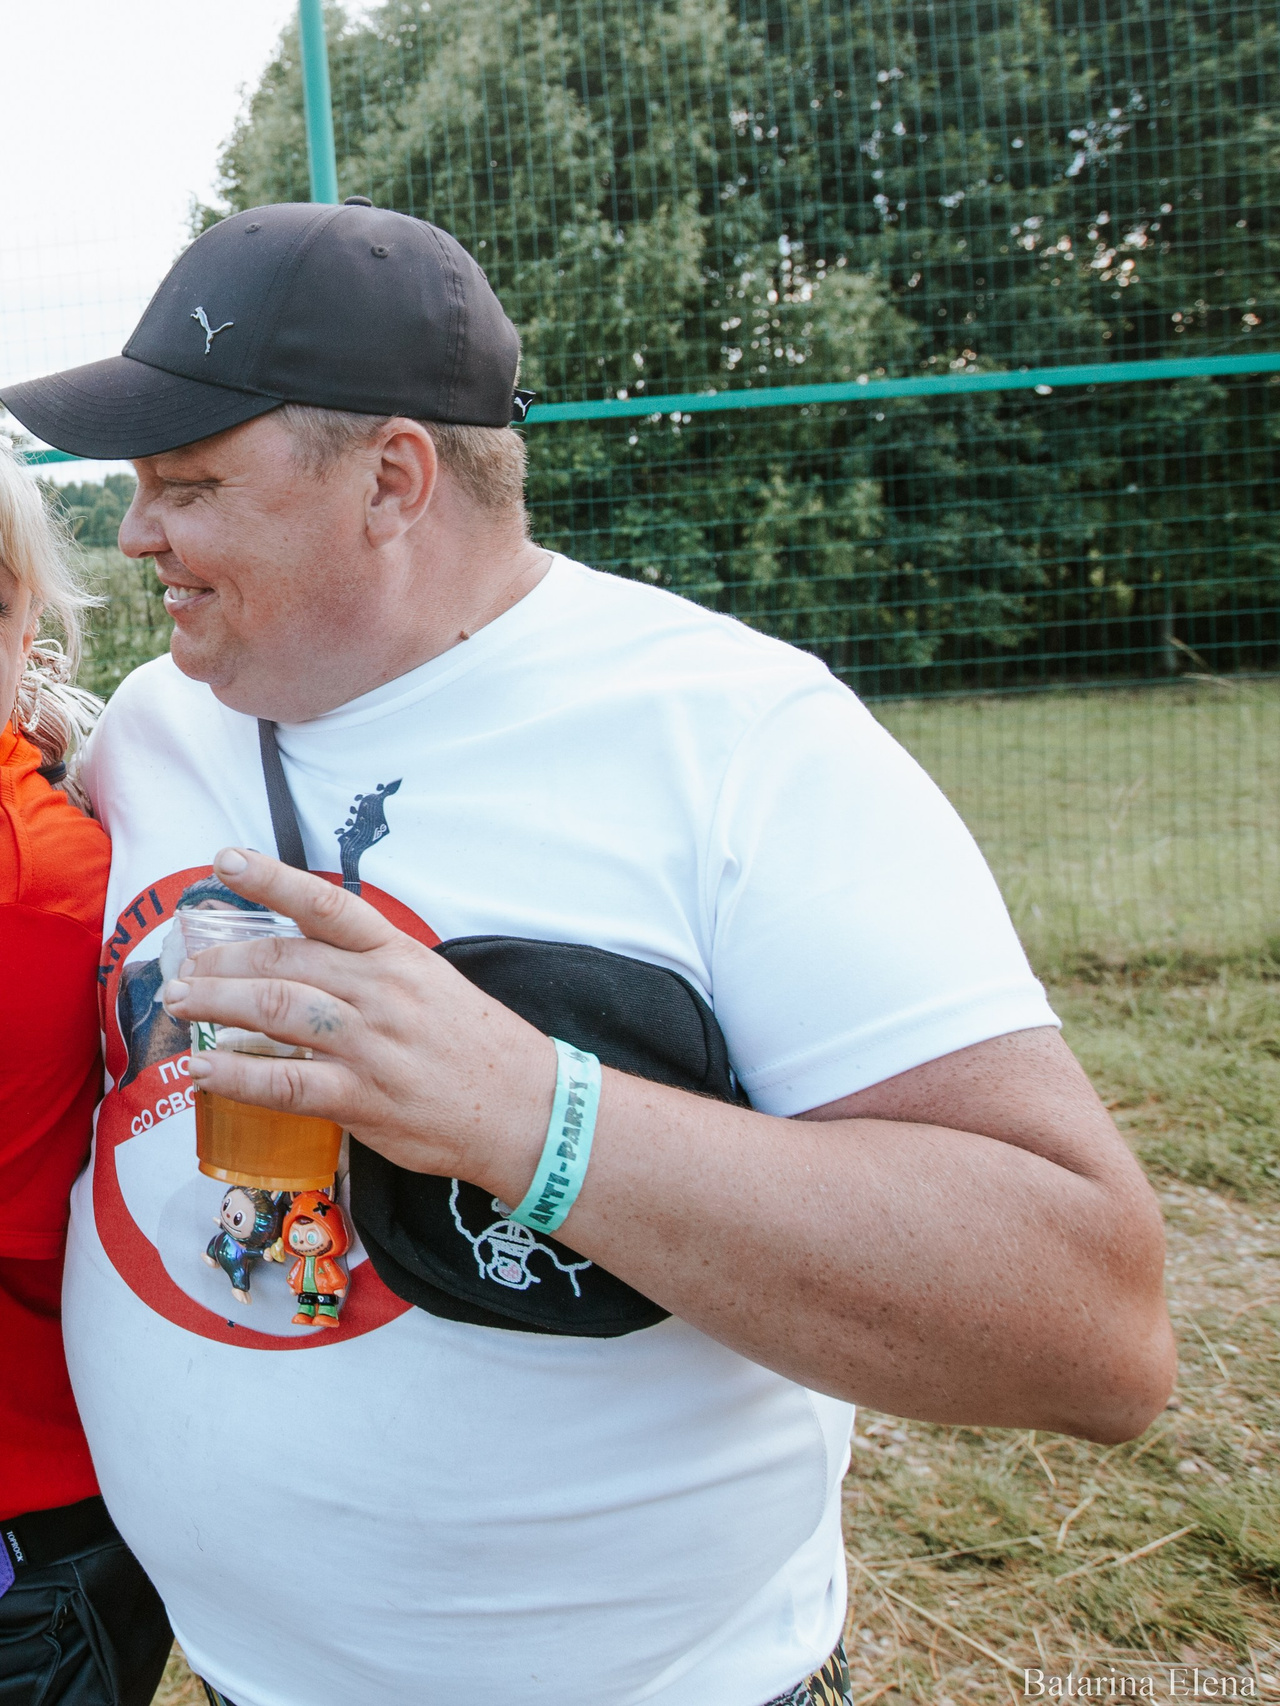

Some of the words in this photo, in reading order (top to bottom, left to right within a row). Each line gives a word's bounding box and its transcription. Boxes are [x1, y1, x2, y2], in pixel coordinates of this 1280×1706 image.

[158, 1055, 191, 1085] ПО
[131, 1109, 154, 1137] СО
[155, 1085, 196, 1121] СВО
[6, 1530, 24, 1563] TOPROCK
